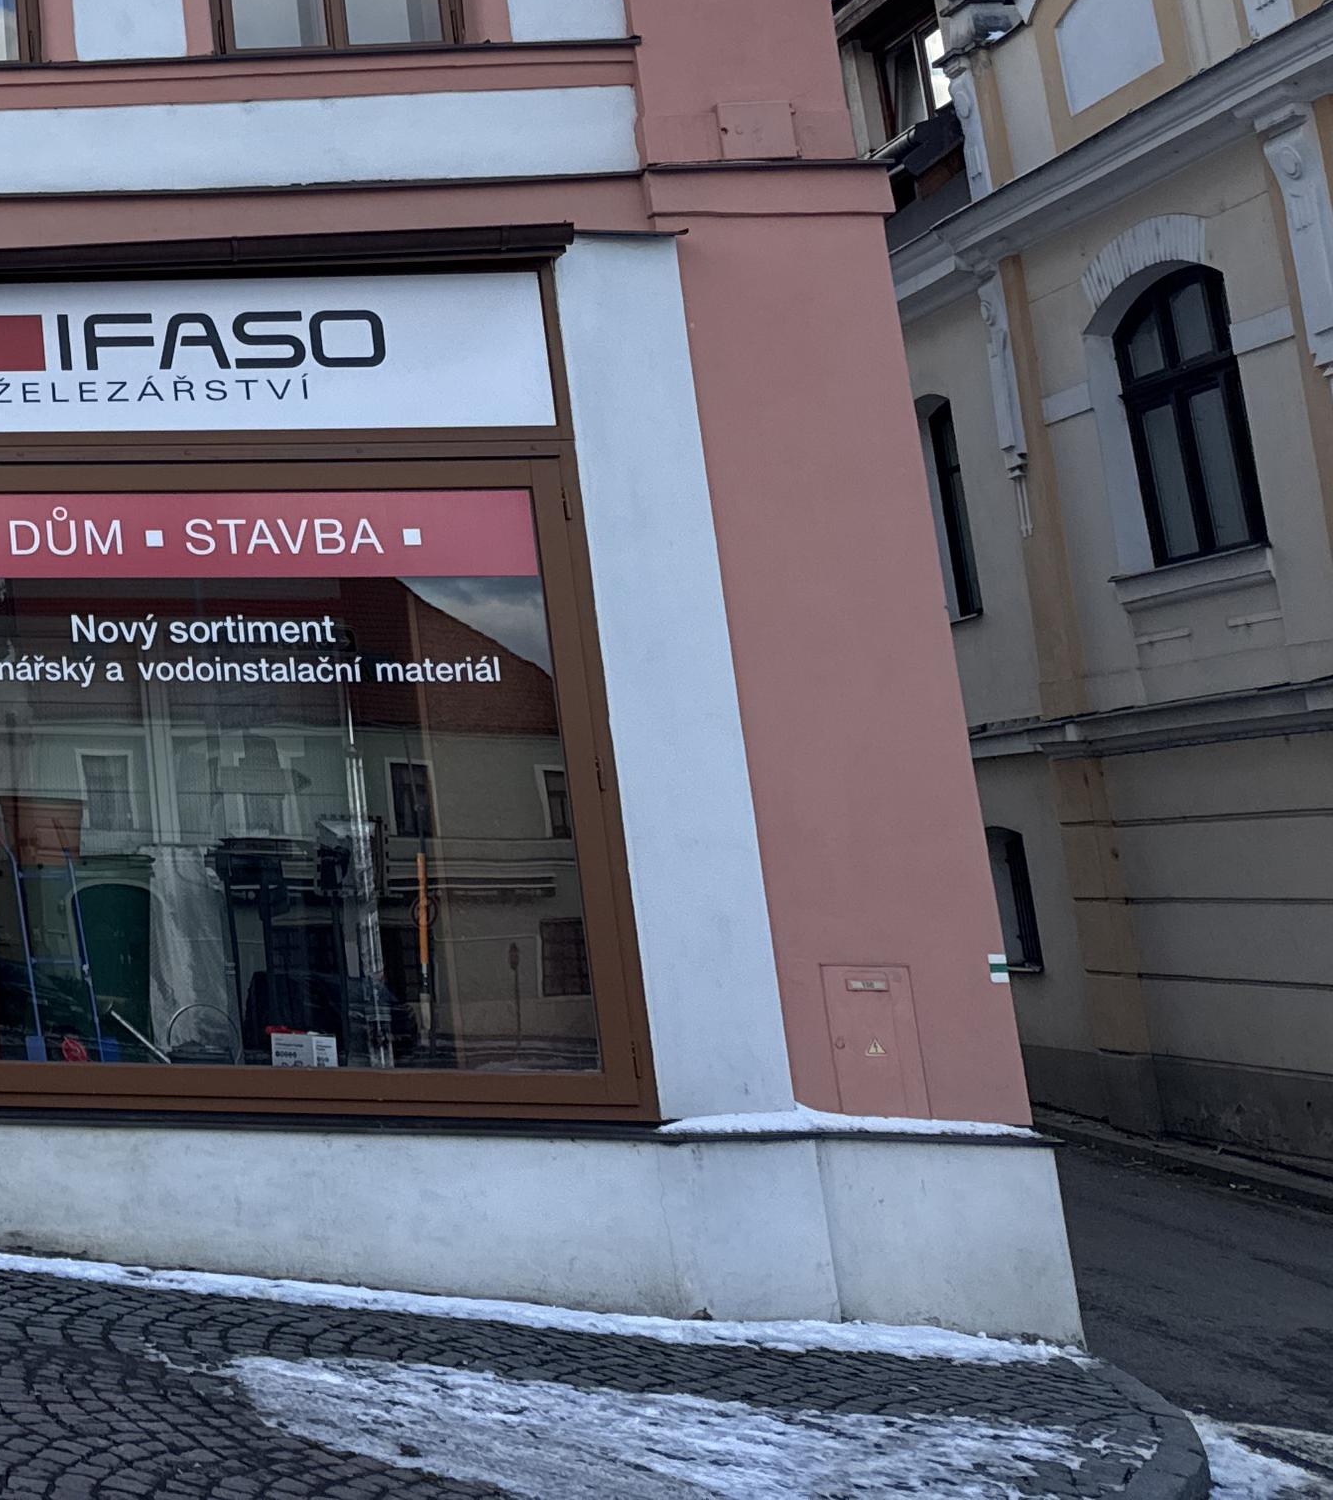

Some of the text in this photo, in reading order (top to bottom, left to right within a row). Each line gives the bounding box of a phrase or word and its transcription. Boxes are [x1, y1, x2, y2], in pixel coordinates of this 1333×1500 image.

[56, 309, 387, 372] IFASO
[8, 506, 385, 556] DŮM STAVBA
[70, 614, 337, 651] Nový sortiment
[105, 660, 125, 683] a
[136, 656, 363, 683] vodoinstalační
[375, 656, 502, 683] materiál
